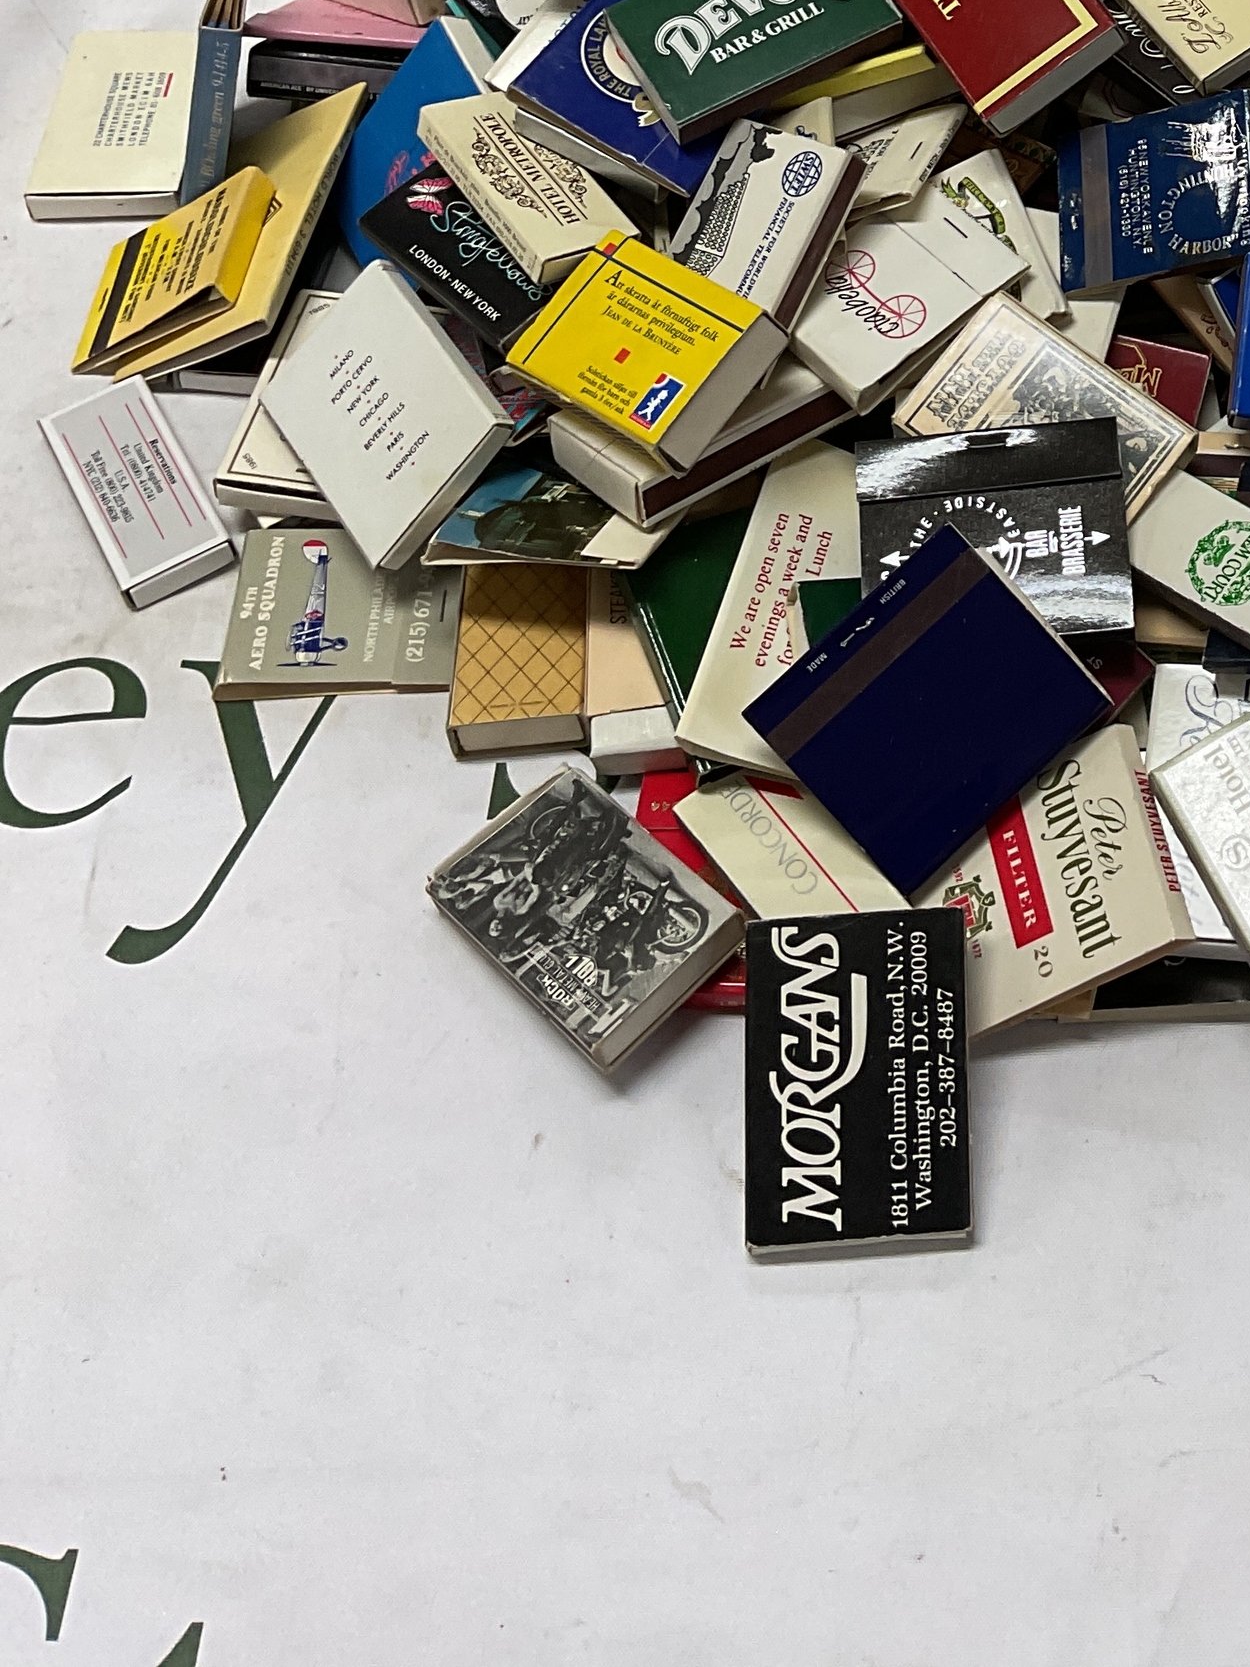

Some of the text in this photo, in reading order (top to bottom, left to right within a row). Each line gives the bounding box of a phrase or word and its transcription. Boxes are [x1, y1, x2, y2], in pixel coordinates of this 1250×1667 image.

[587, 43, 633, 96] THE ROYAL
[480, 111, 548, 188] METROPOLE
[795, 152, 814, 194] SWIFT
[540, 180, 582, 226] HOTEL
[408, 245, 502, 322] LONDON NEW YORK
[605, 270, 624, 290] Att
[624, 285, 651, 305] skratta
[701, 326, 719, 343] folk
[329, 349, 355, 380] MILANO
[331, 354, 374, 405] PORTO CERVO
[346, 374, 381, 414] NEW YORK
[358, 392, 390, 428] CHICAGO
[363, 402, 406, 452] BEVERLY HILLS
[386, 431, 405, 453] PARIS
[133, 442, 164, 494] United Kingdom
[149, 438, 178, 485] Reservations
[385, 430, 430, 481] WASHINGTON
[943, 495, 1022, 547] EASTSIDE
[1024, 528, 1049, 559] BAR
[1059, 505, 1087, 576] BRASSERIE
[805, 529, 833, 577] Lunch
[240, 586, 259, 620] 94TH
[248, 535, 286, 671] AERO SQUADRON
[730, 513, 789, 651] We are open seven
[755, 513, 813, 668] evenings week and
[879, 579, 907, 606] BRITISH
[404, 621, 426, 664] (215)
[806, 651, 829, 673] MADE
[719, 778, 818, 897] CONCORDE
[1036, 759, 1122, 959] Stuyvesant
[1083, 794, 1127, 882] Peter
[1001, 828, 1039, 932] FILTER
[1156, 850, 1182, 893] PETER
[566, 953, 599, 986] ROLL
[1033, 943, 1055, 980] 20
[543, 975, 574, 1005] ROCK
[770, 925, 867, 1233] MORGANS
[908, 930, 936, 1211] Washington, D.C. 20009
[937, 988, 957, 1149] 202-387-8487
[888, 1057, 909, 1173] Columbia
[889, 1179, 909, 1229] 1811
